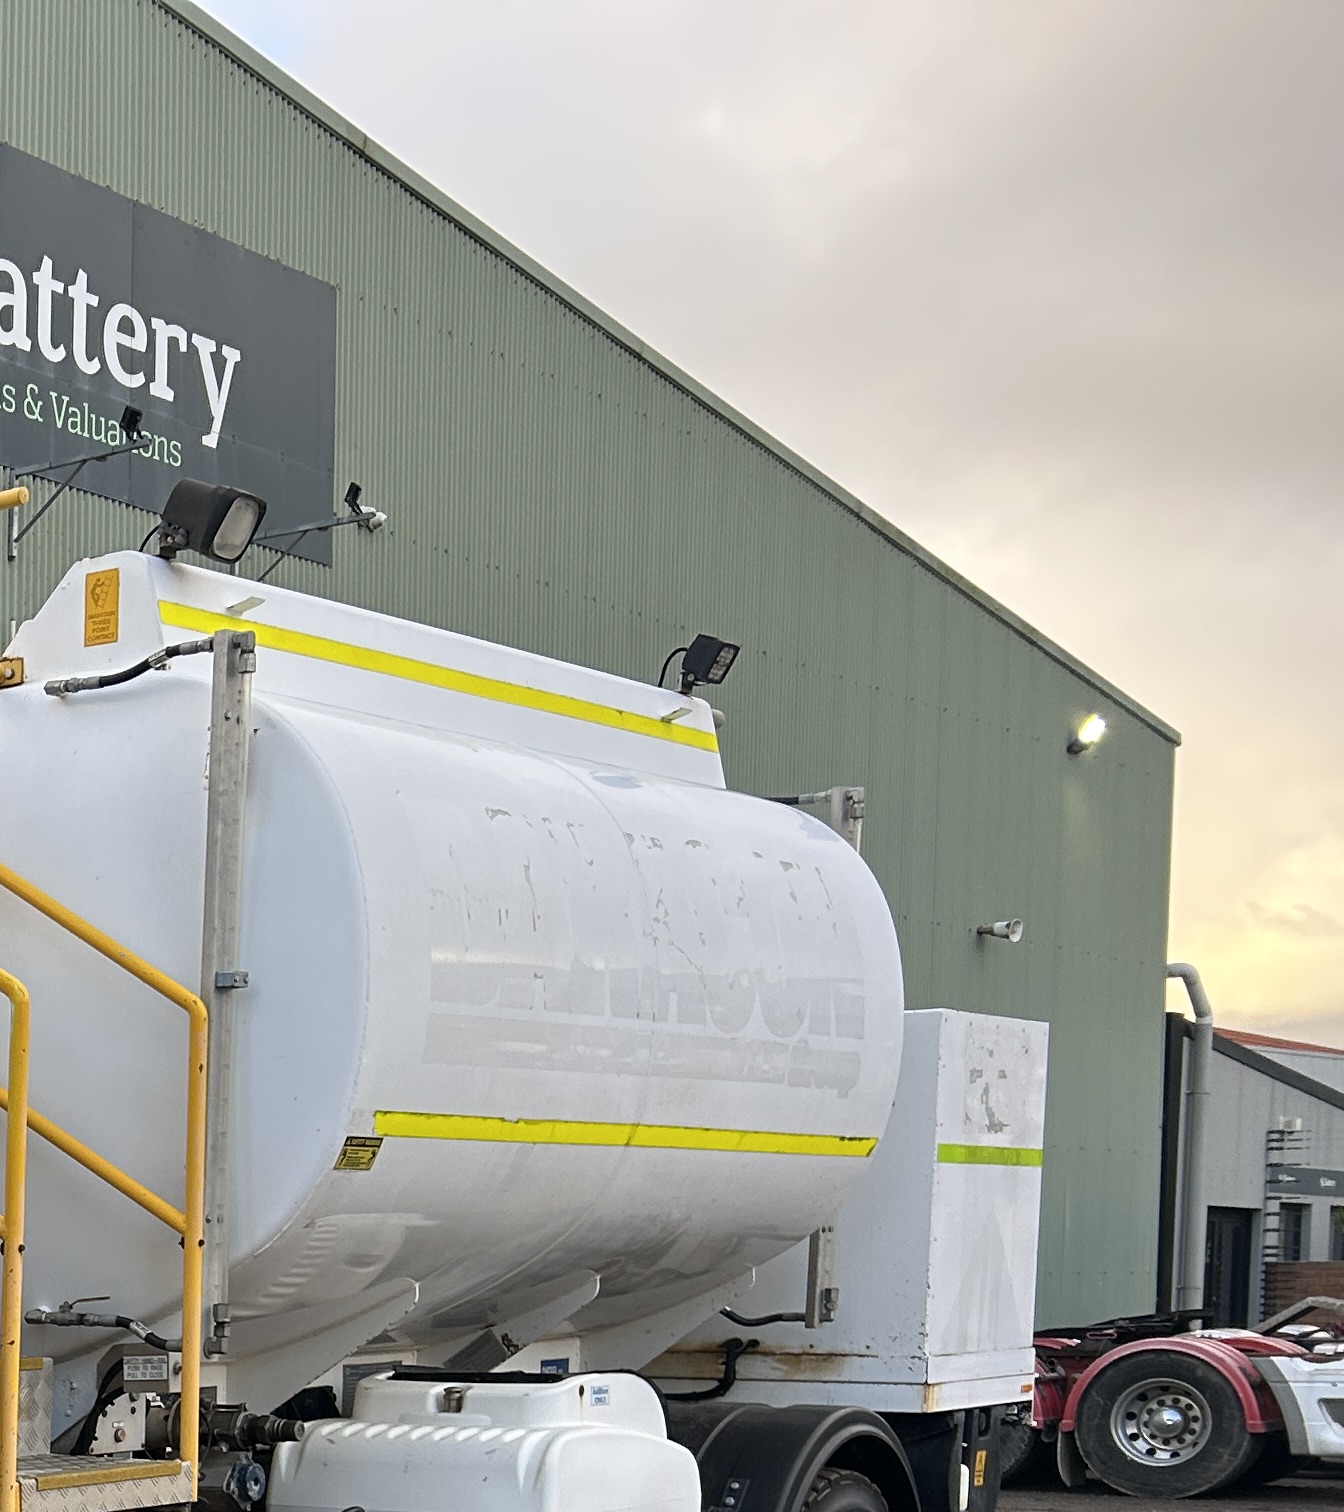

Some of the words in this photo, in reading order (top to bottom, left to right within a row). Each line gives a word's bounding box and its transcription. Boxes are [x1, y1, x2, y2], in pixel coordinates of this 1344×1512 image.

[23, 383, 44, 423] &
[49, 390, 182, 467] Valuaons
[87, 610, 116, 620] MAINTAIN
[92, 625, 110, 634] POINT
[87, 632, 115, 643] CONTACT
